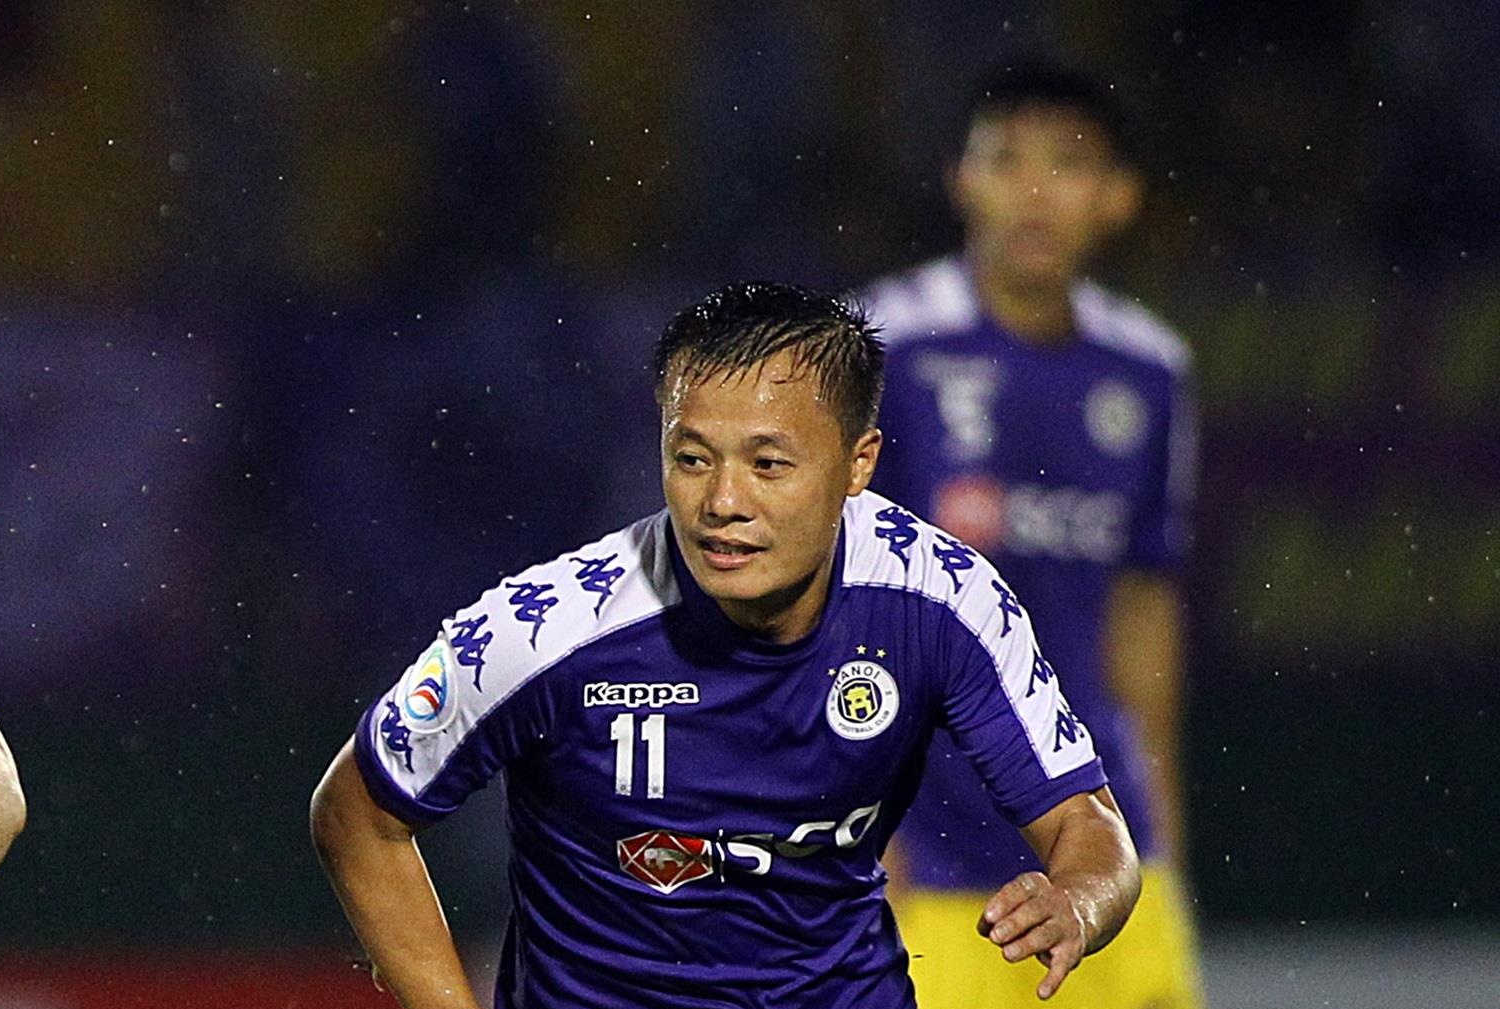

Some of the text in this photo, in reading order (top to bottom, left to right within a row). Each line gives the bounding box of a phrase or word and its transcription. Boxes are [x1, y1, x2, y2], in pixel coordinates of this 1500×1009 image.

[833, 665, 881, 691] HANOI
[584, 681, 700, 709] Kappa
[610, 713, 666, 799] 11
